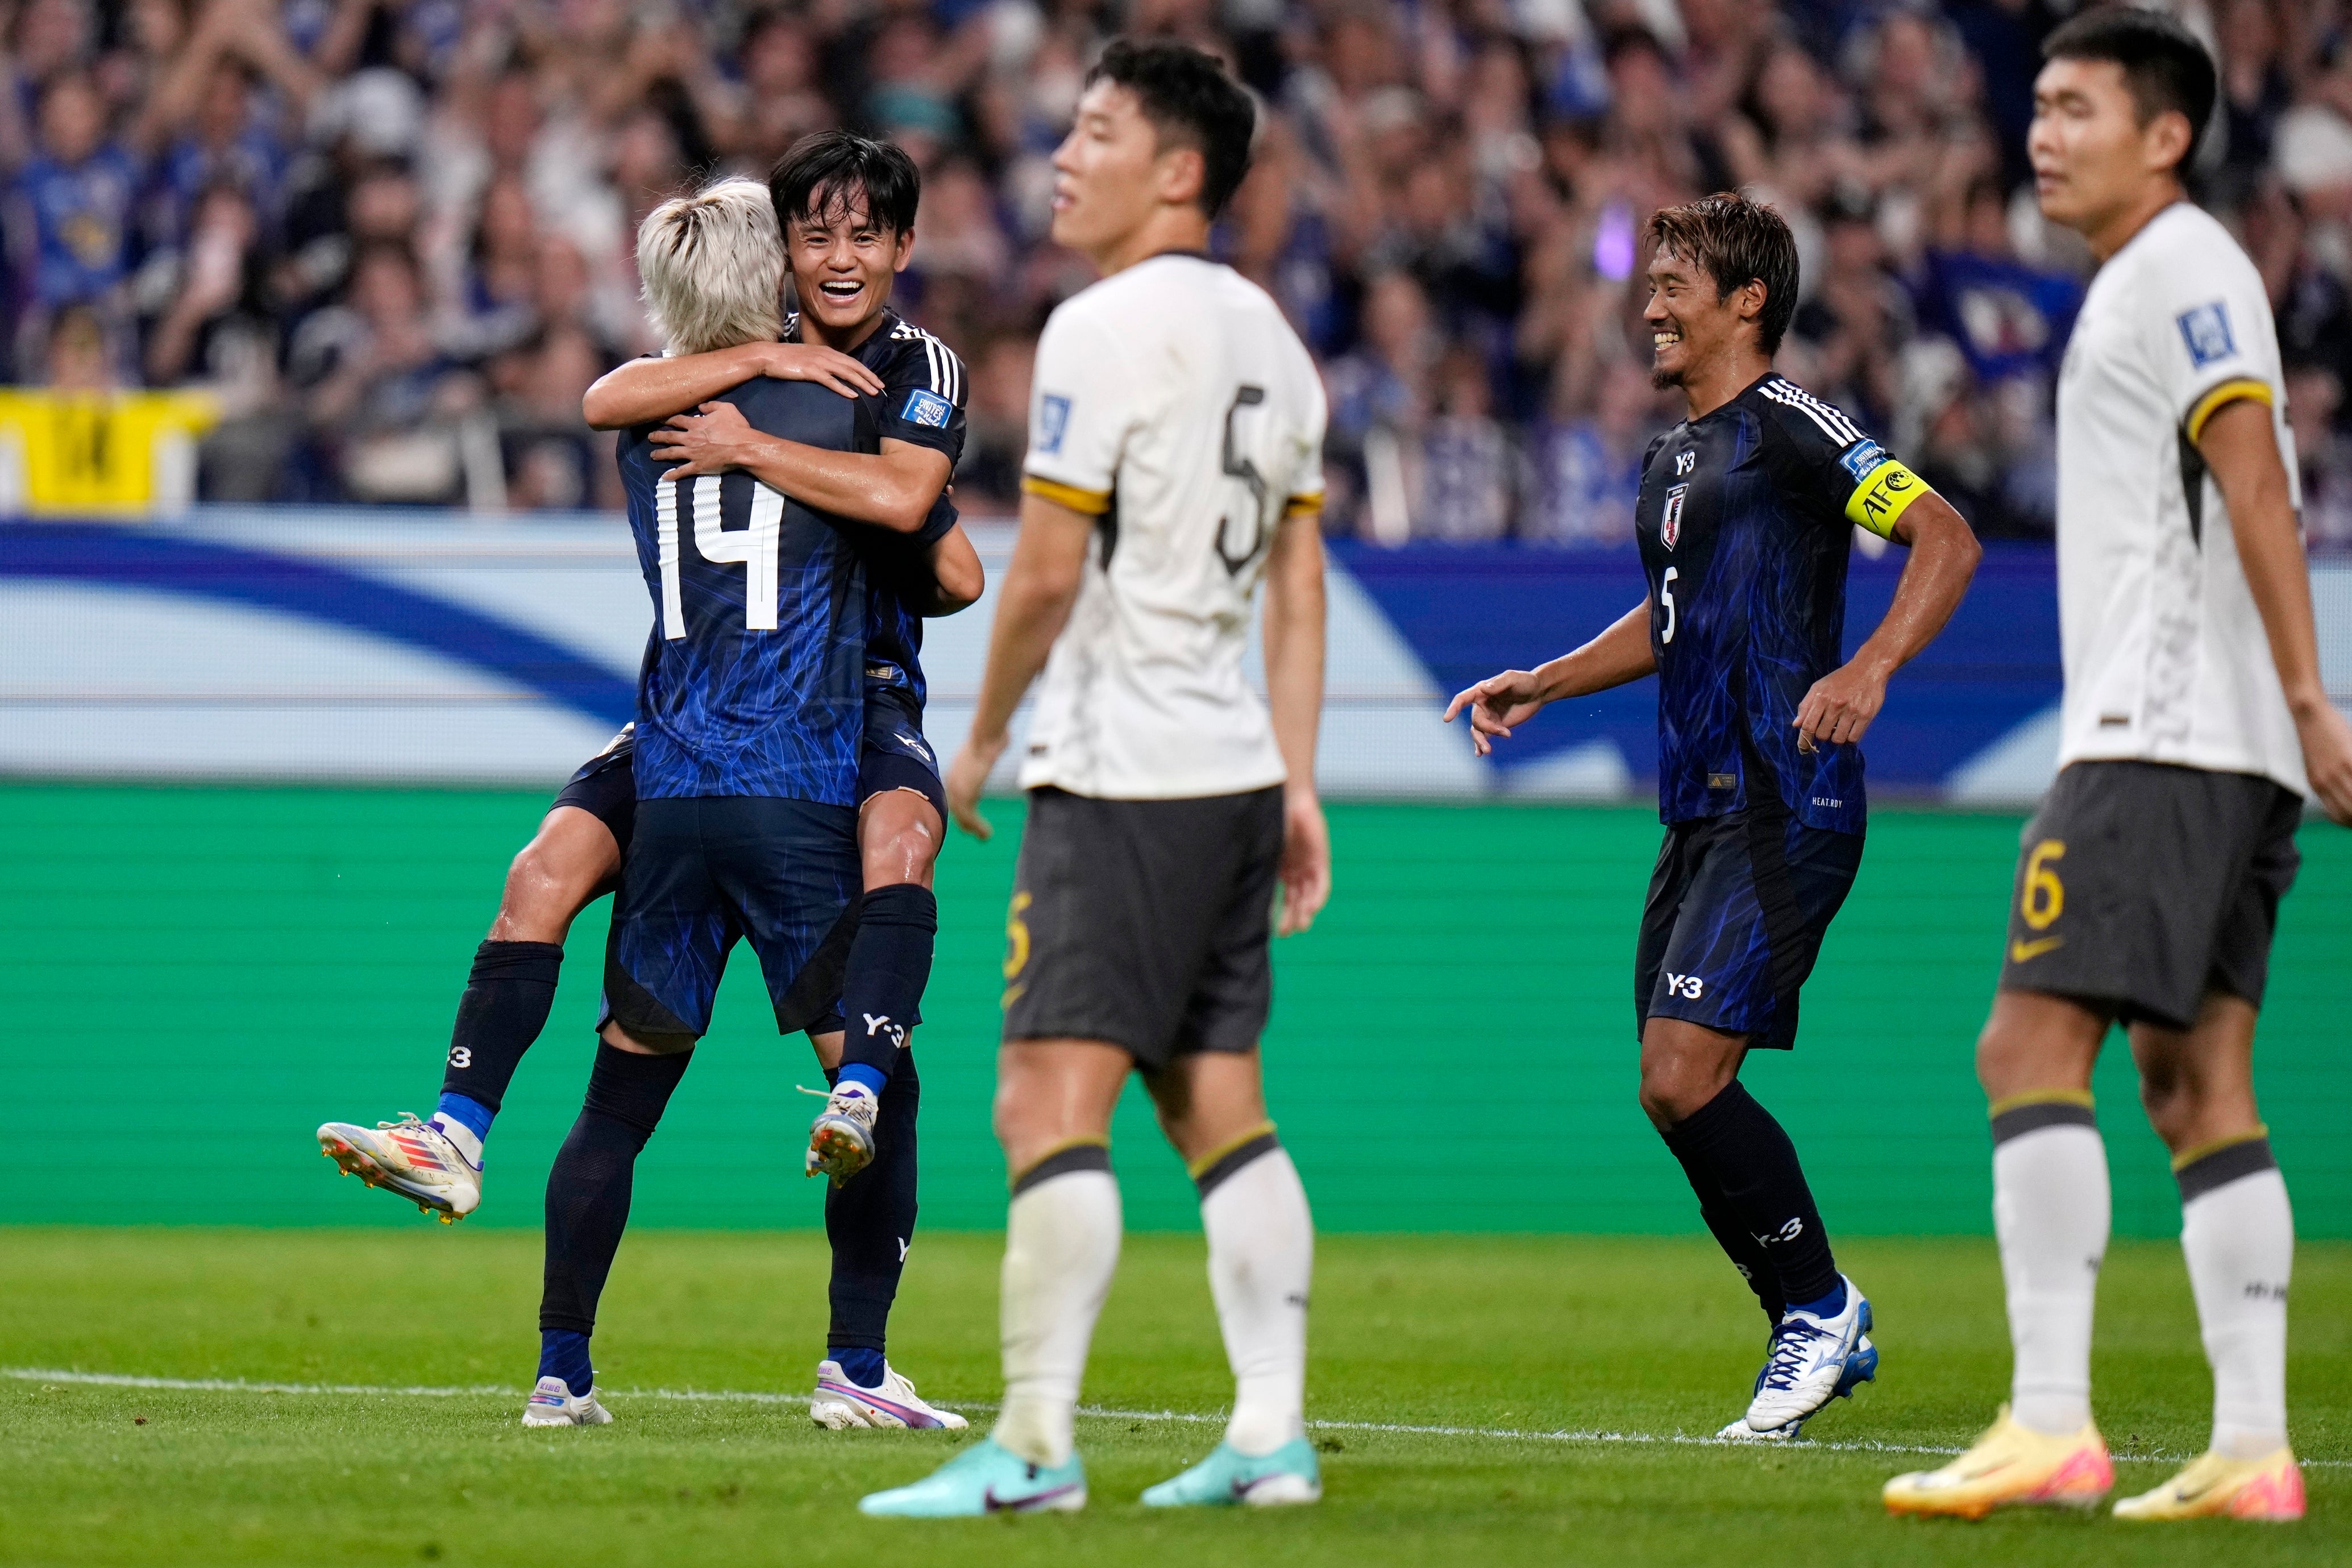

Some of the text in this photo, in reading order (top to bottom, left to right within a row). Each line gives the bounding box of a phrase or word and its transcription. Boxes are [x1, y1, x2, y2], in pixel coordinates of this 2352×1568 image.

[1676, 451, 1695, 476] Y-3
[1854, 446, 1877, 464] FOOTBALL
[1214, 385, 1266, 578] 5
[655, 468, 785, 640] 14
[1661, 566, 1678, 644] 5
[1812, 796, 1843, 808] HEAT.RDY
[2021, 839, 2066, 930] 6
[1667, 972, 1703, 999] Y-3
[863, 1013, 905, 1049] Y-3
[1751, 1217, 1803, 1249] Y-3
[540, 1382, 561, 1393] KING
